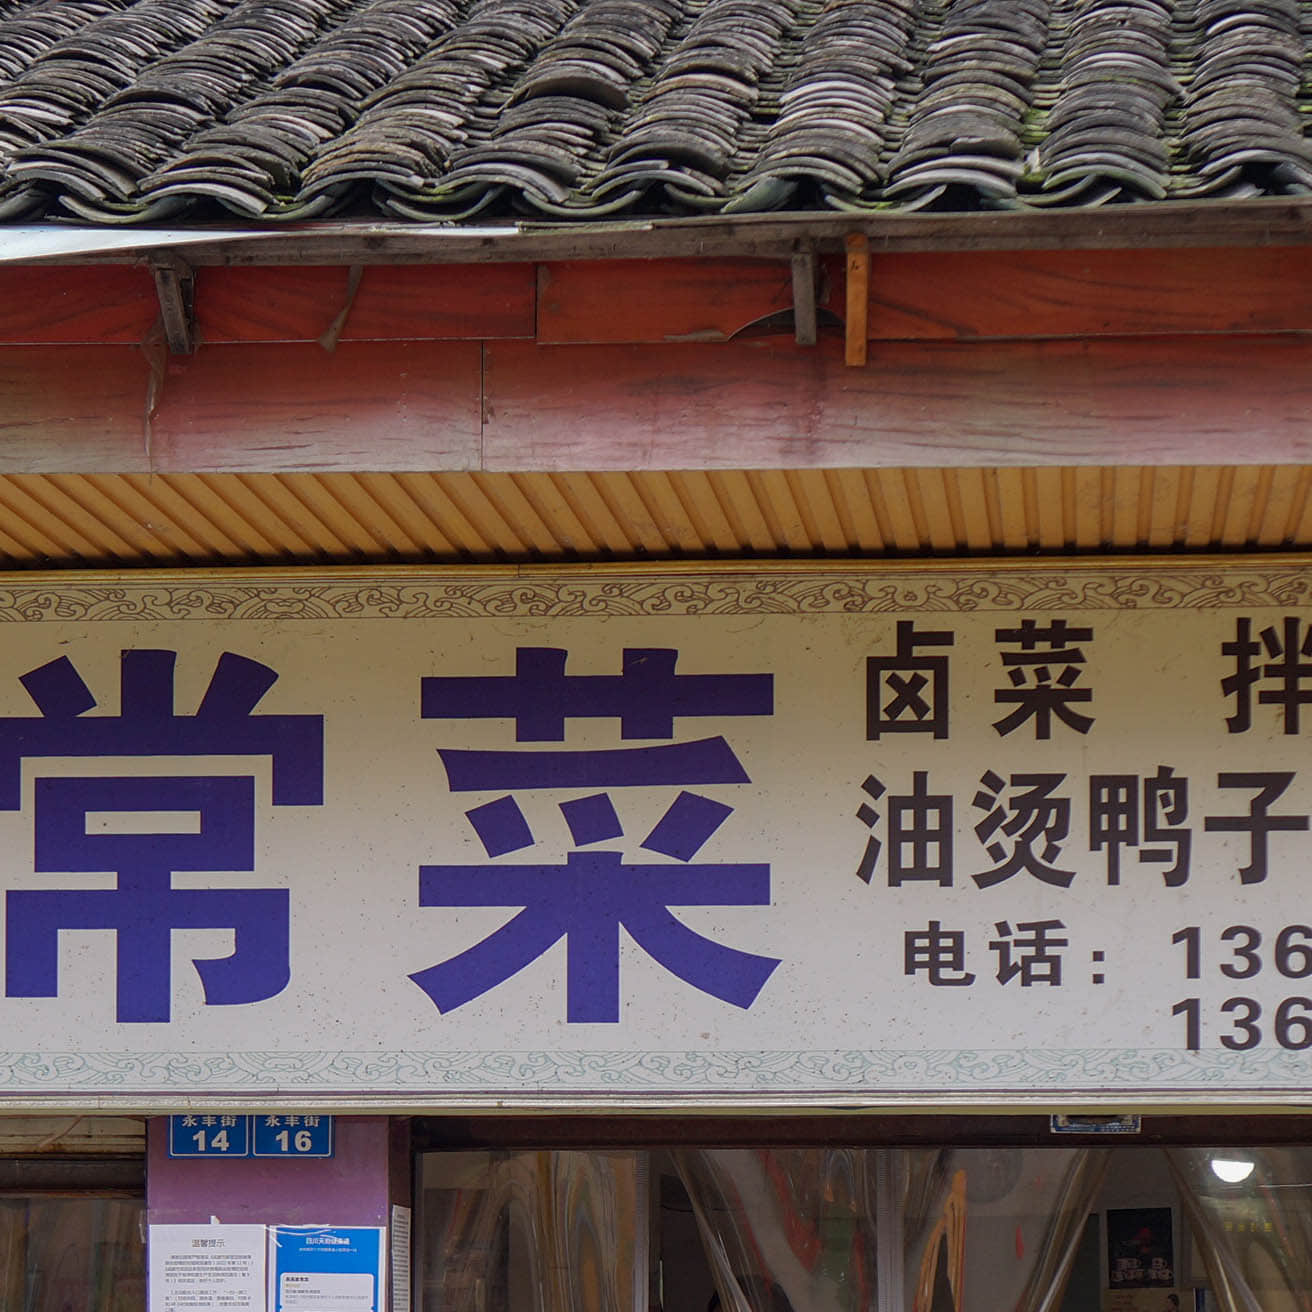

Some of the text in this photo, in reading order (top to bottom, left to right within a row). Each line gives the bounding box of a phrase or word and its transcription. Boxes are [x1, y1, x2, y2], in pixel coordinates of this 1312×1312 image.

[865, 619, 1094, 740] 卤菜
[855, 764, 1310, 889] 油烫鸭子
[181, 1115, 238, 1128] 永丰街
[264, 1115, 321, 1128] 永丰街
[192, 1130, 230, 1152] 14
[275, 1130, 313, 1152] 16
